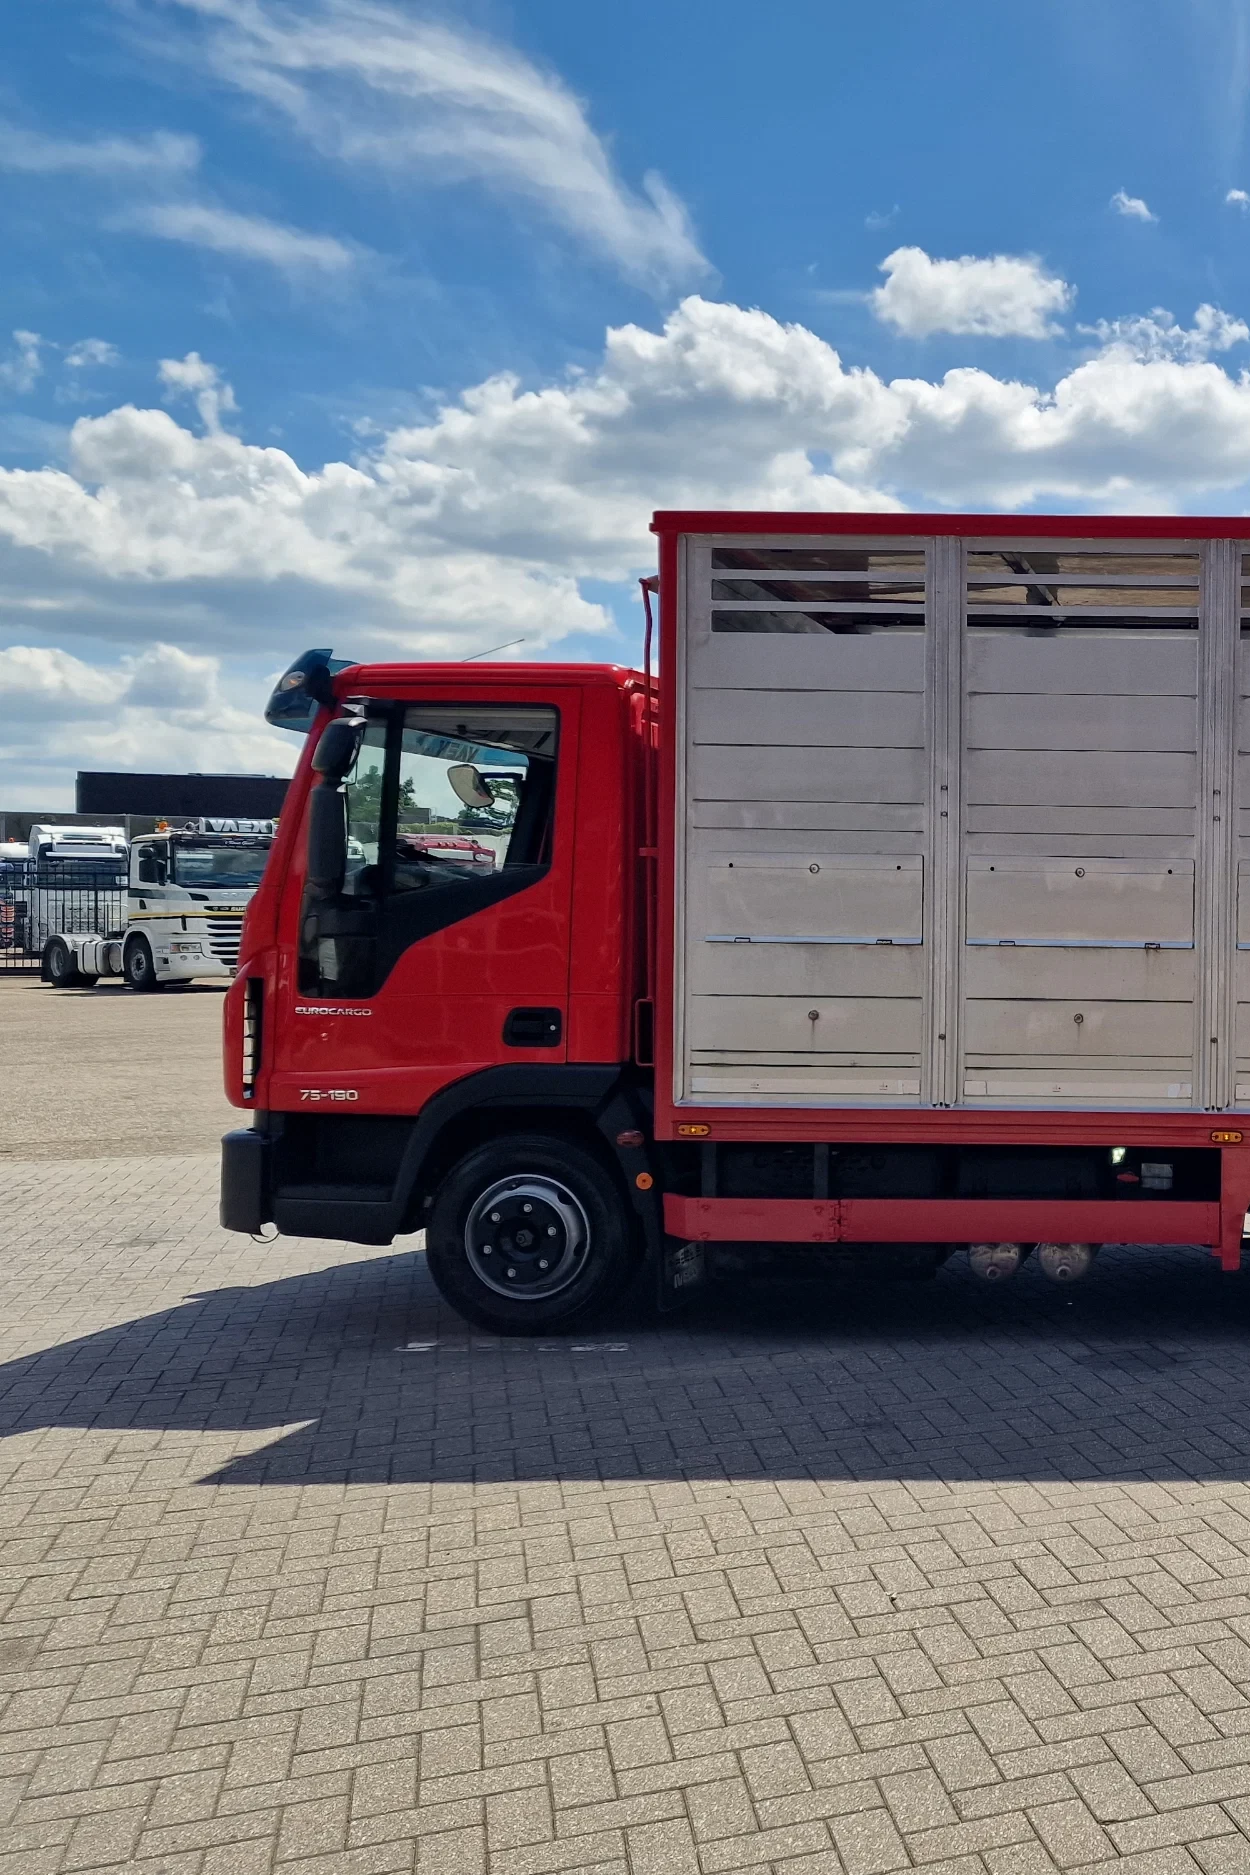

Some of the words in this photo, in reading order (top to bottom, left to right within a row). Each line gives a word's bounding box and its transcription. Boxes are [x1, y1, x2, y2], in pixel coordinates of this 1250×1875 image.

[208, 819, 269, 833] VAEX
[294, 1006, 372, 1016] EUROCARGO
[300, 1089, 359, 1101] 75-190
